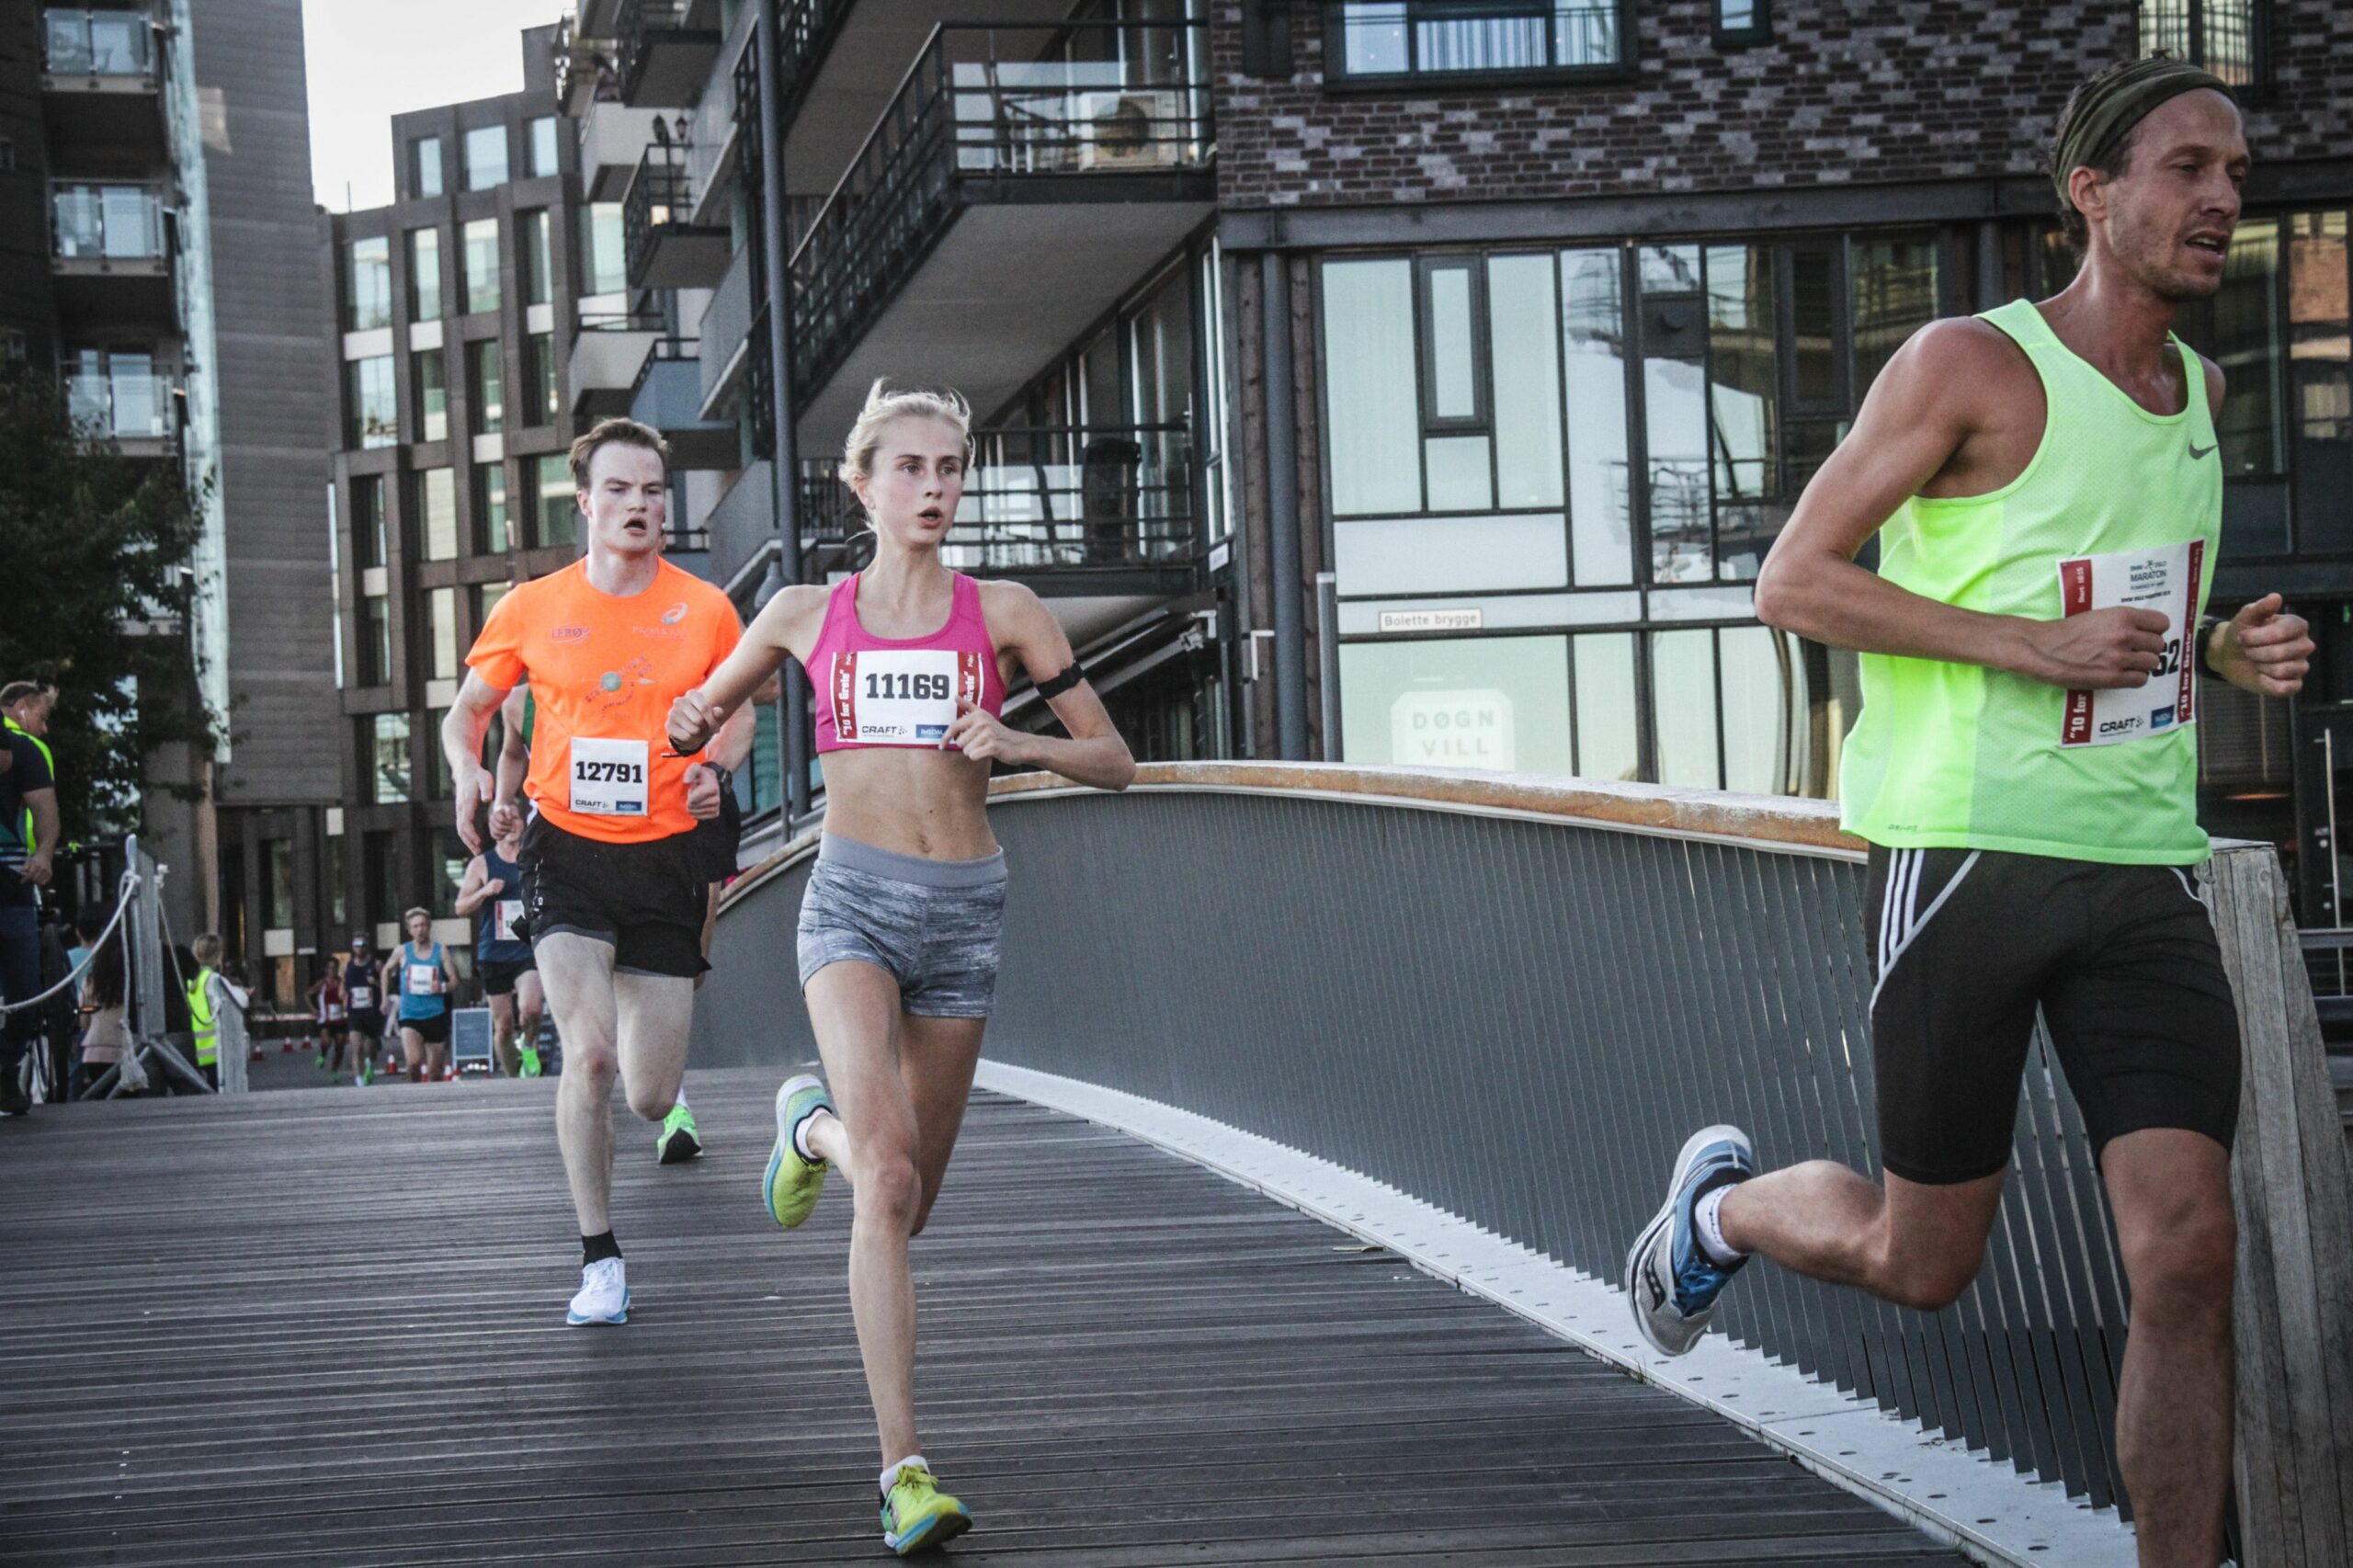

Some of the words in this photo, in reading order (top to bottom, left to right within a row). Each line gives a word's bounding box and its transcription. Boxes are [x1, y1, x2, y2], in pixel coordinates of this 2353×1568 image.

[2130, 569, 2167, 582] MARATON
[1435, 613, 1477, 626] brygge
[866, 673, 950, 700] 11169
[1413, 710, 1495, 730] DØGN
[2099, 717, 2136, 733] CRAFT
[861, 725, 898, 735] CRAFT
[1422, 739, 1489, 756] VILL
[575, 761, 642, 783] 12791
[575, 800, 602, 808] CRAFT
